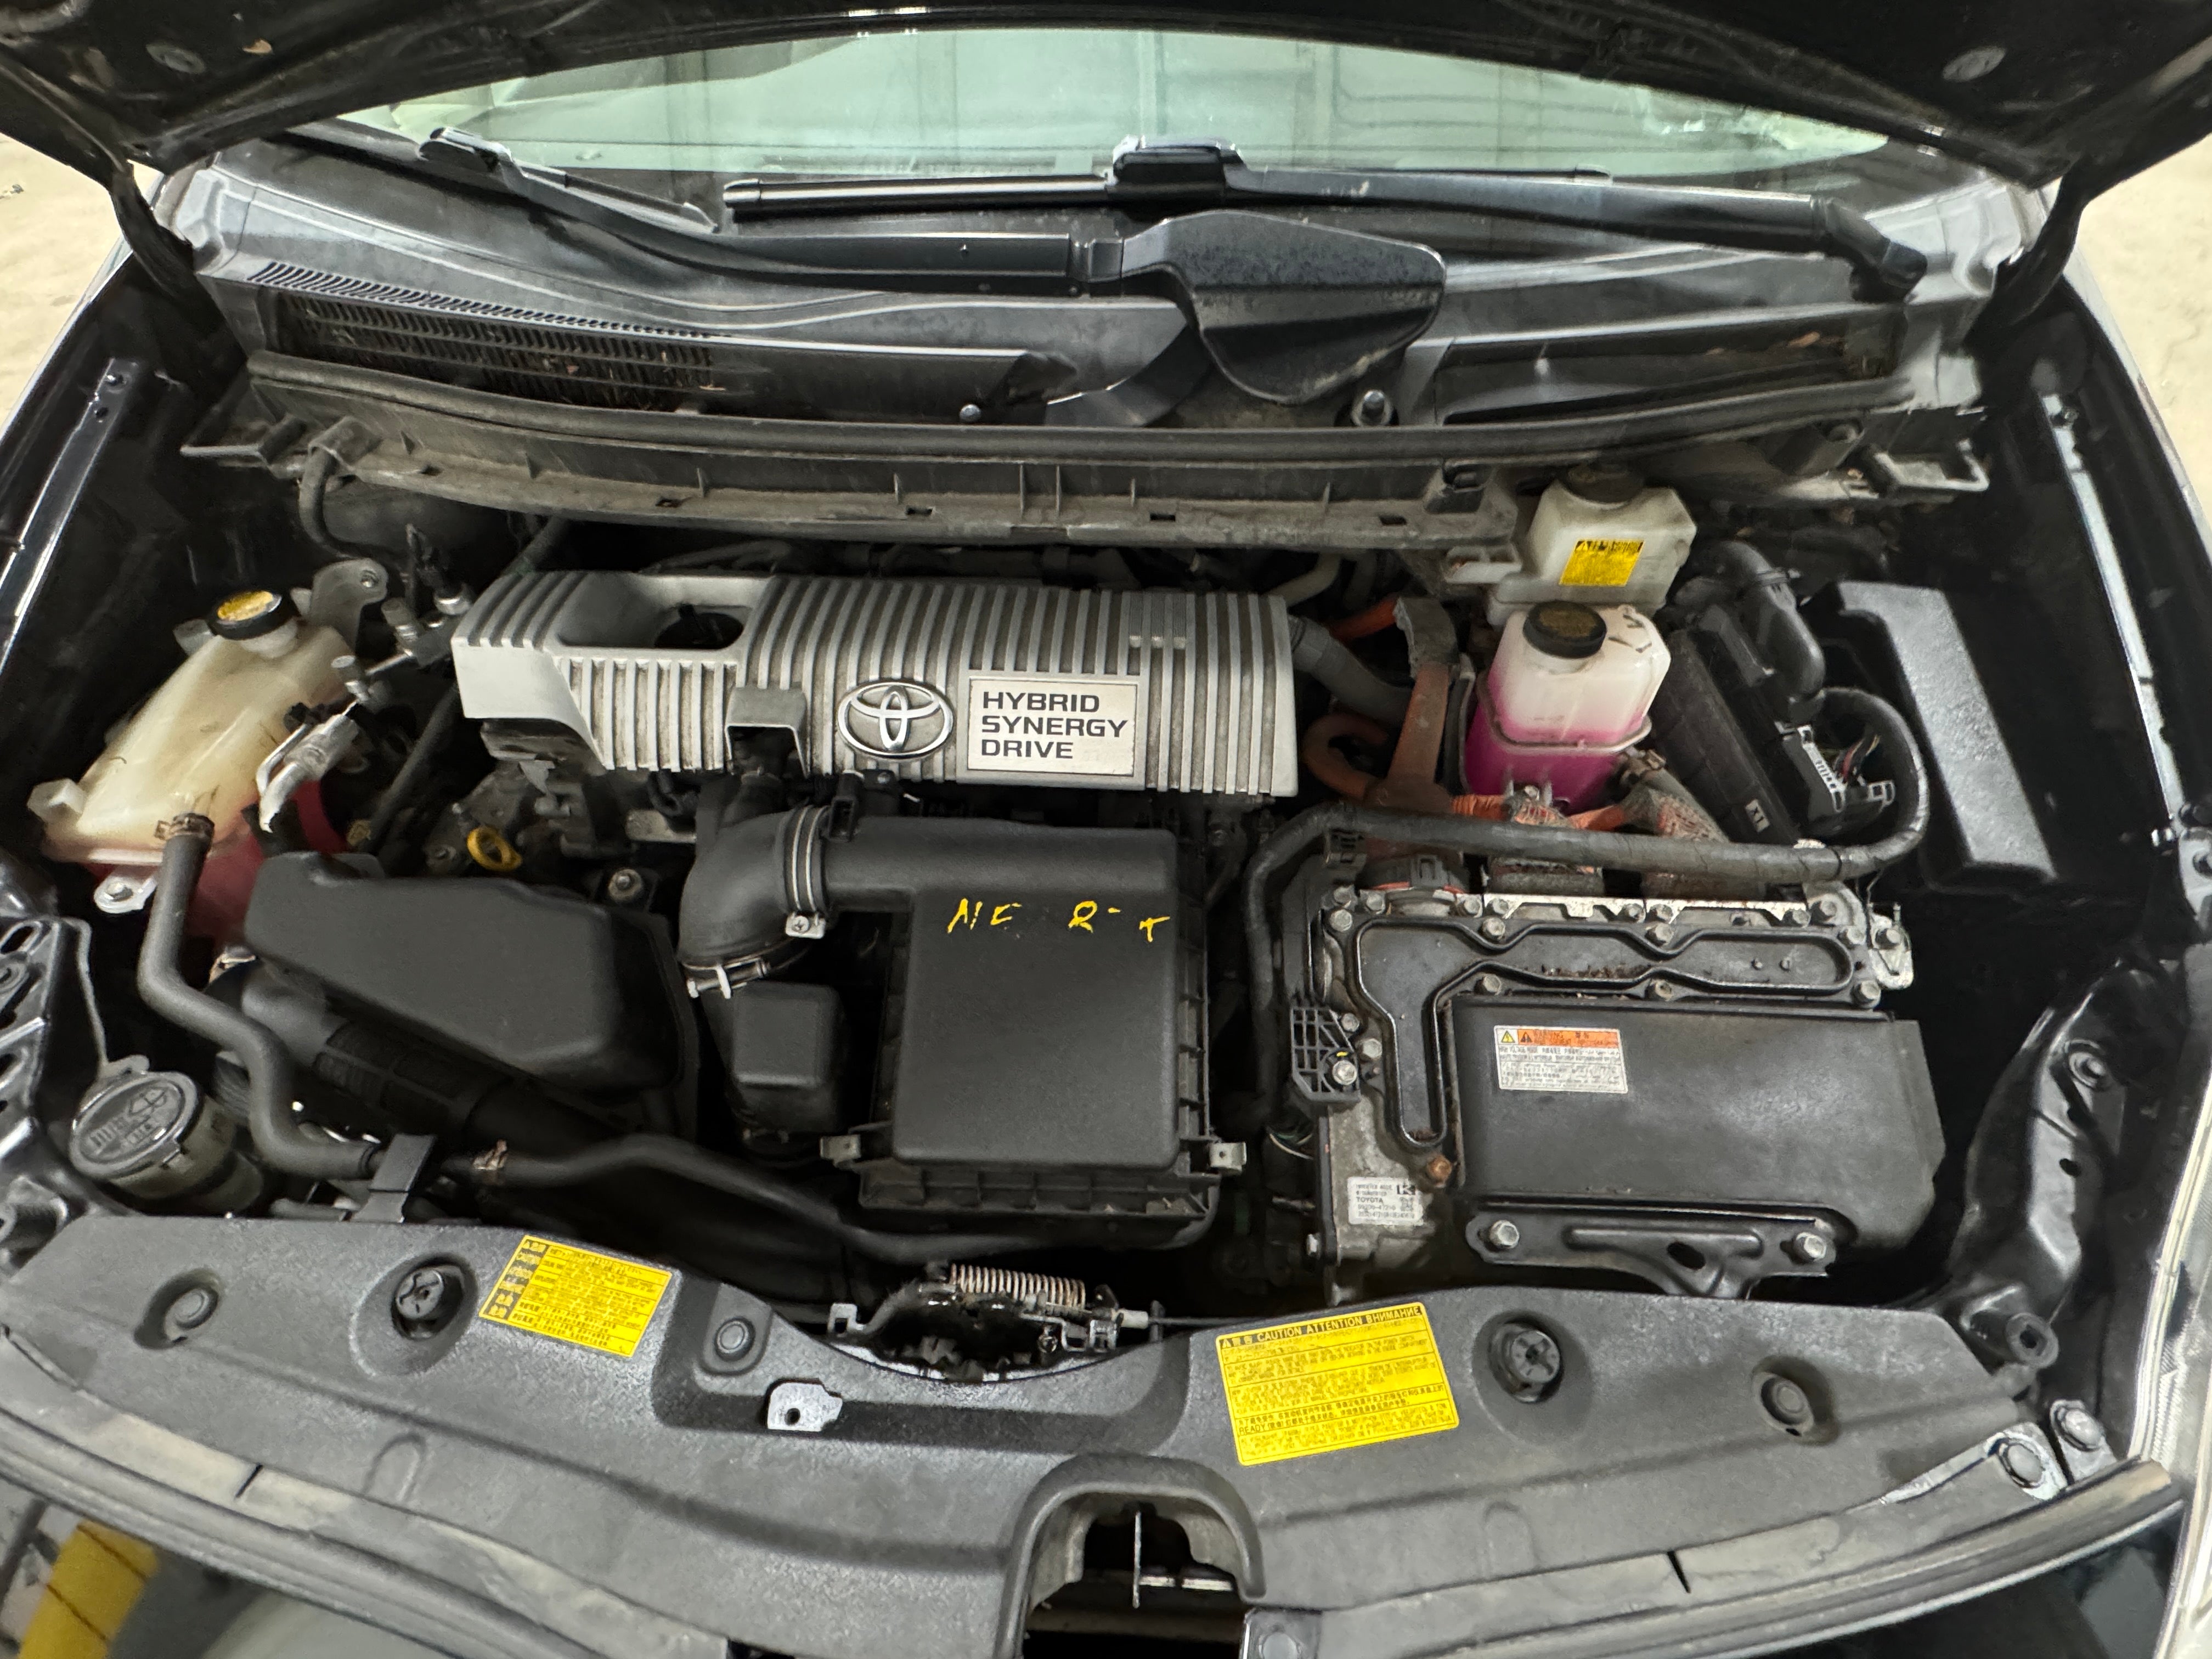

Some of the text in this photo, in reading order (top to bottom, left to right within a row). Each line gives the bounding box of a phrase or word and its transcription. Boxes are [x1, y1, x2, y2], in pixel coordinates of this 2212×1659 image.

[983, 691, 1099, 712] HYBRID
[981, 715, 1127, 737] SYNERGY
[981, 739, 1073, 759] DRIVE
[1257, 1326, 1302, 1342] CAUTION
[1307, 1317, 1363, 1334] ATTENTION
[1366, 1307, 1420, 1324] ВНИМАНИЕ
